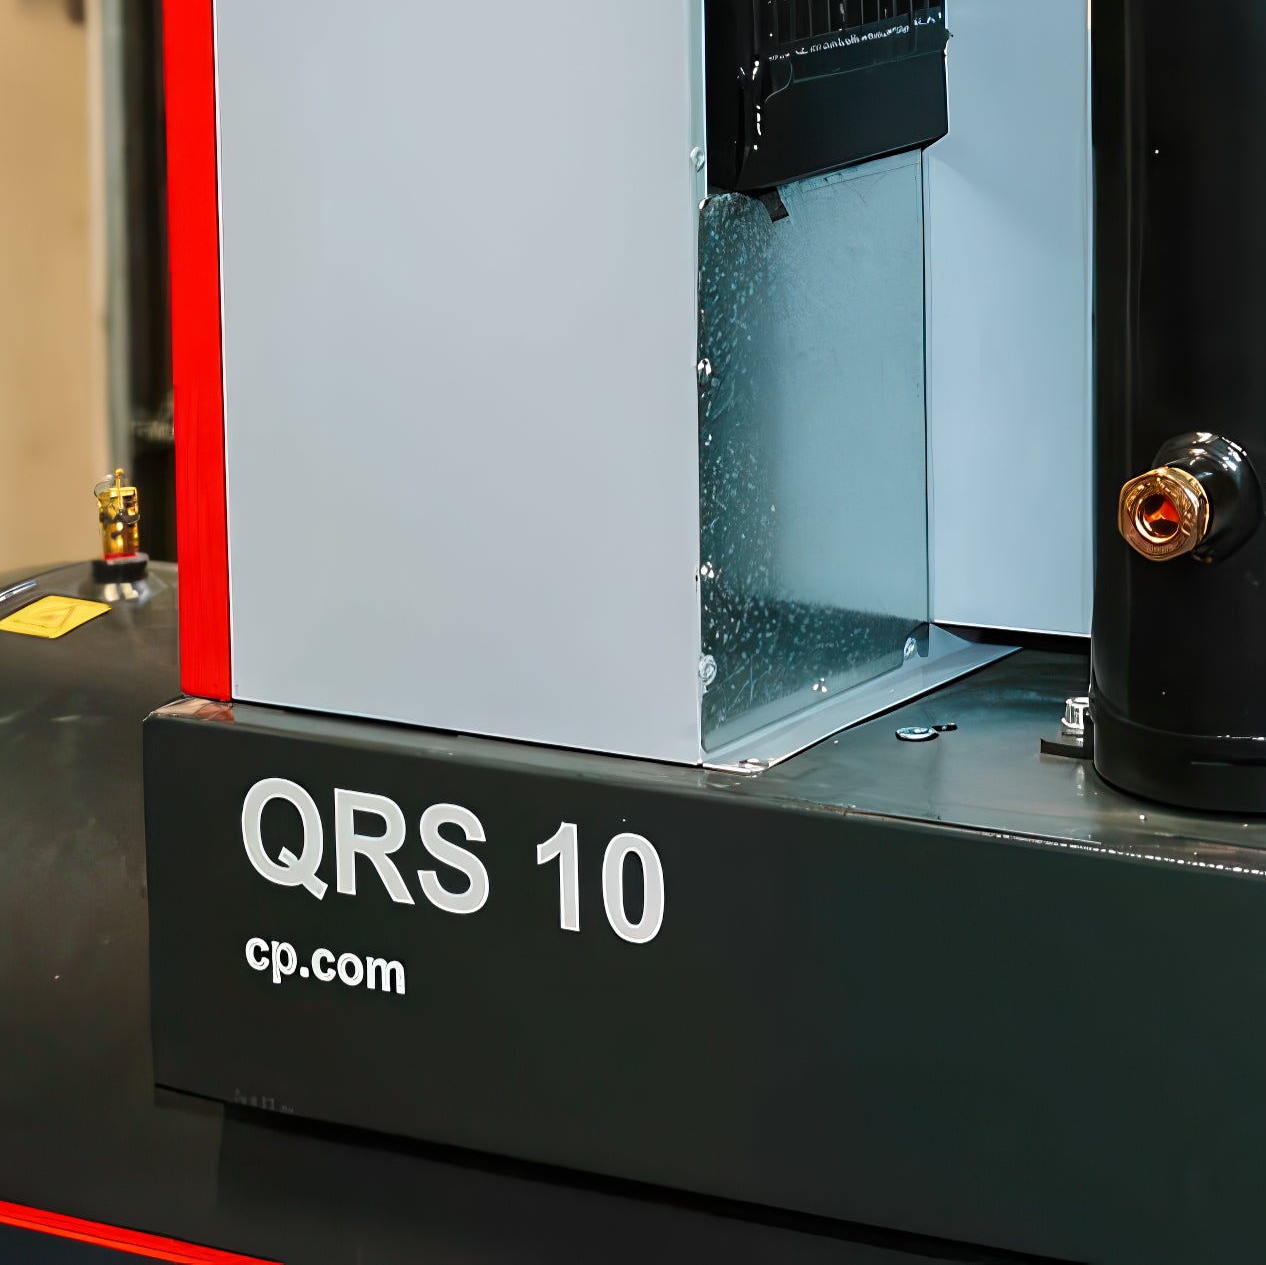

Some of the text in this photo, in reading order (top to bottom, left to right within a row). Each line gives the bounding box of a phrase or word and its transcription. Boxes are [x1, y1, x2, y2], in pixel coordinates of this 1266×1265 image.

[241, 777, 665, 944] QRS 10
[245, 936, 406, 995] cp.com
